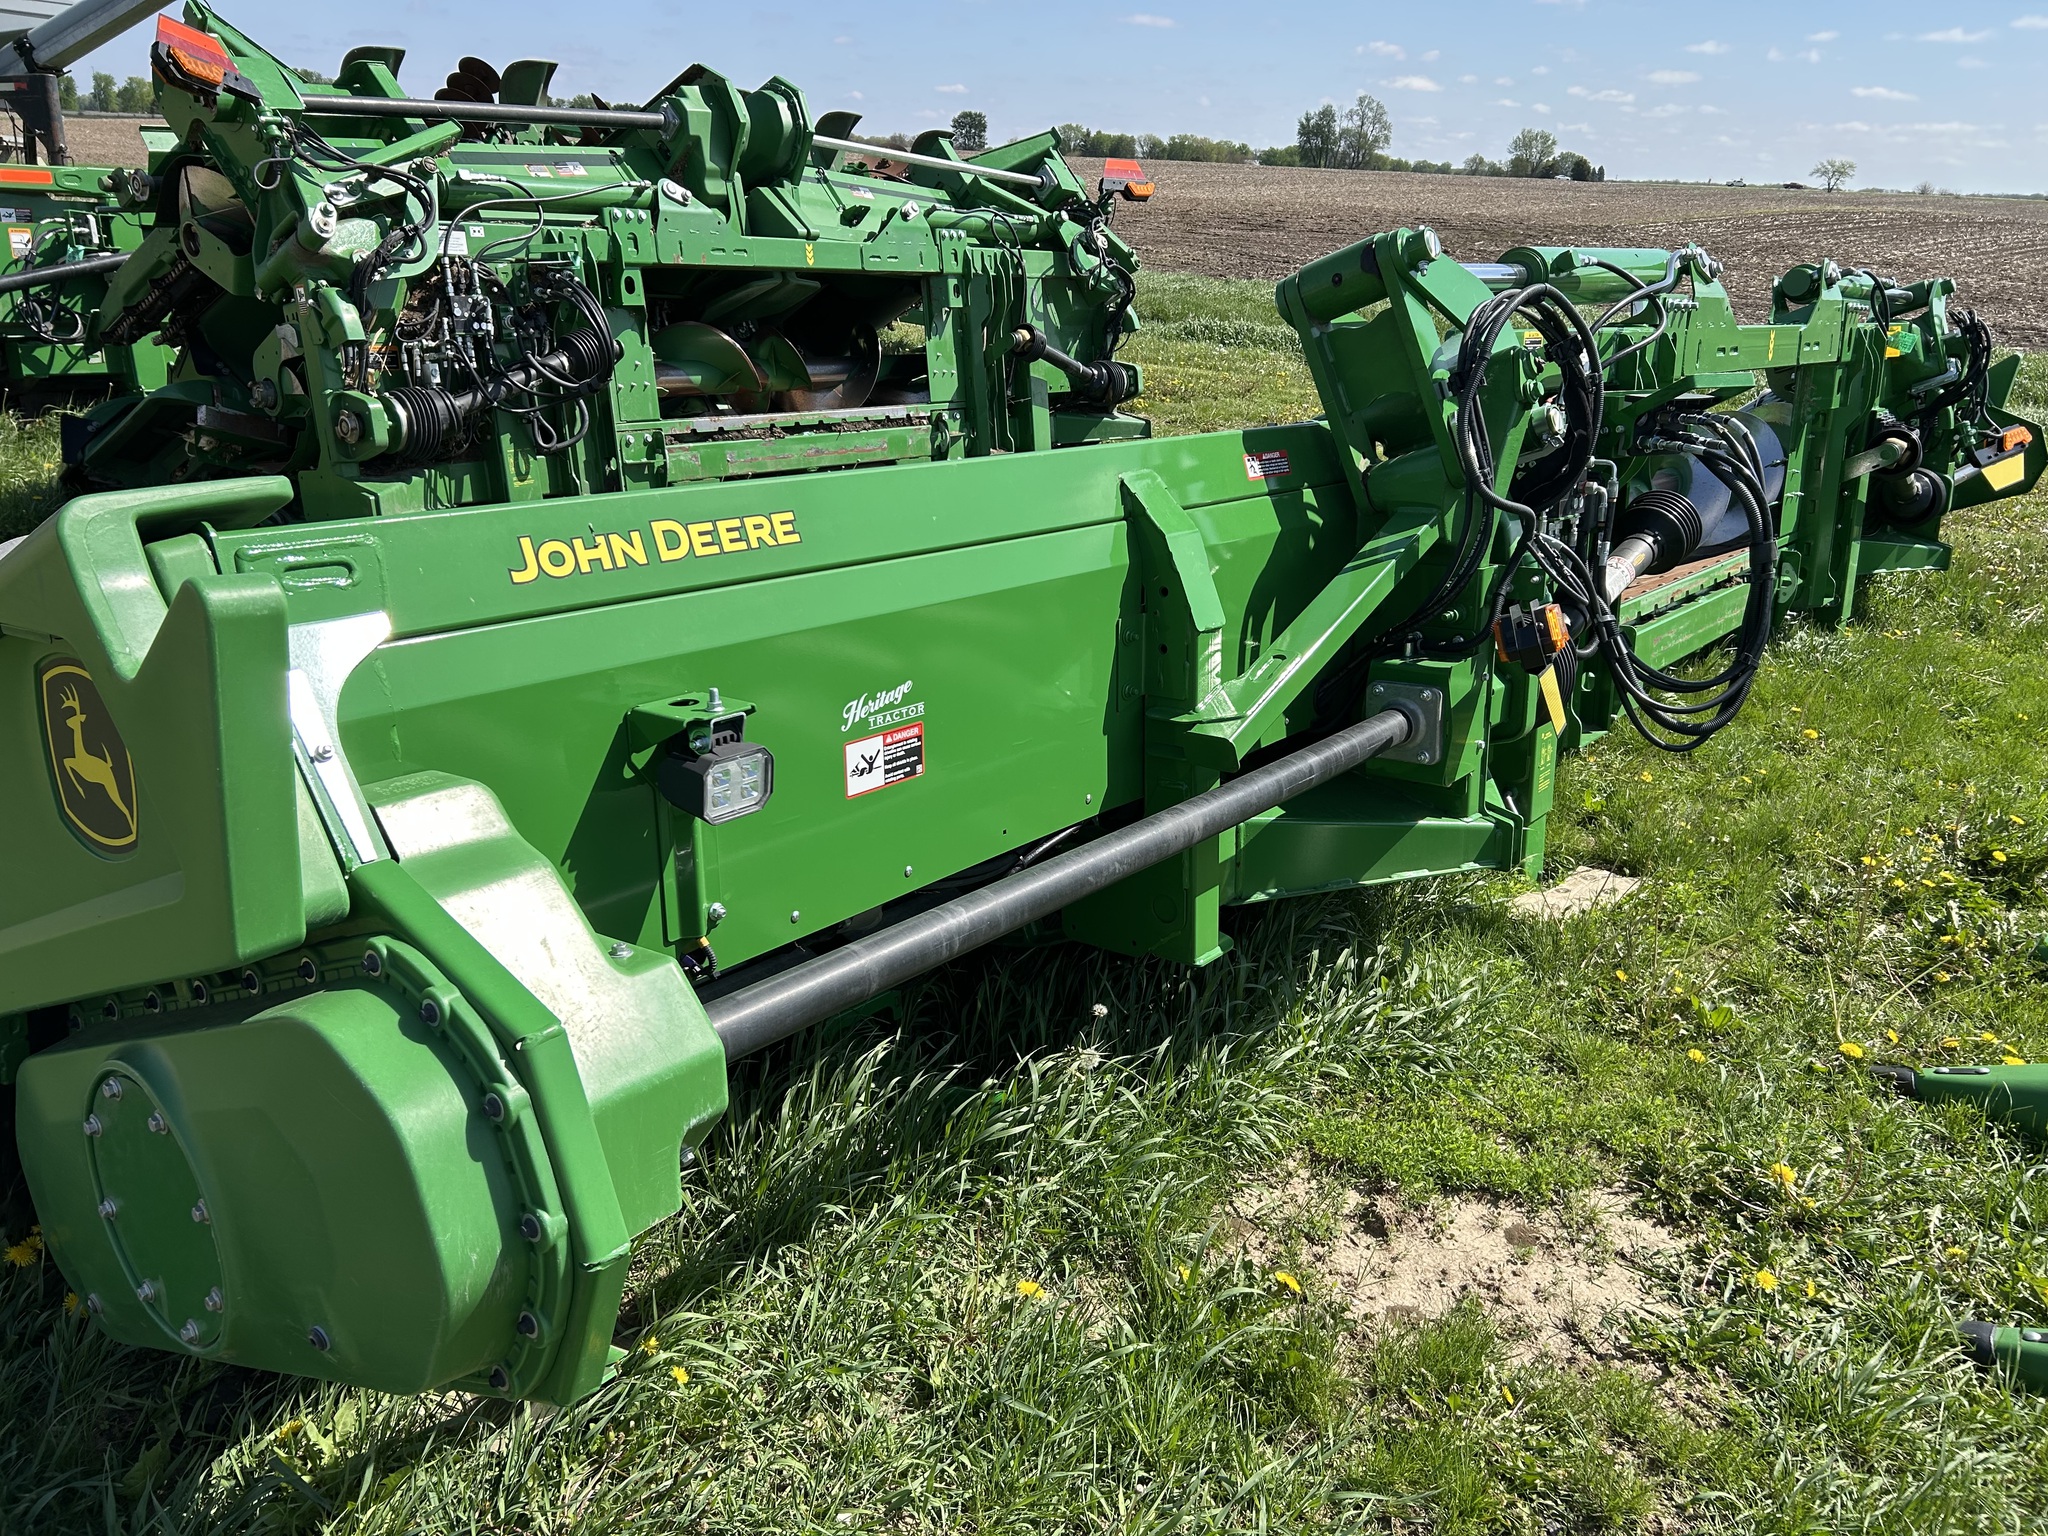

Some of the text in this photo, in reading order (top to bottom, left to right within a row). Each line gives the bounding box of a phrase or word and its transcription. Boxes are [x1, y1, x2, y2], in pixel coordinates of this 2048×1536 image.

[508, 510, 803, 585] JOHN DEERE
[841, 680, 913, 732] Heritage
[868, 704, 925, 728] TRACTOR
[892, 727, 919, 741] DANGER
